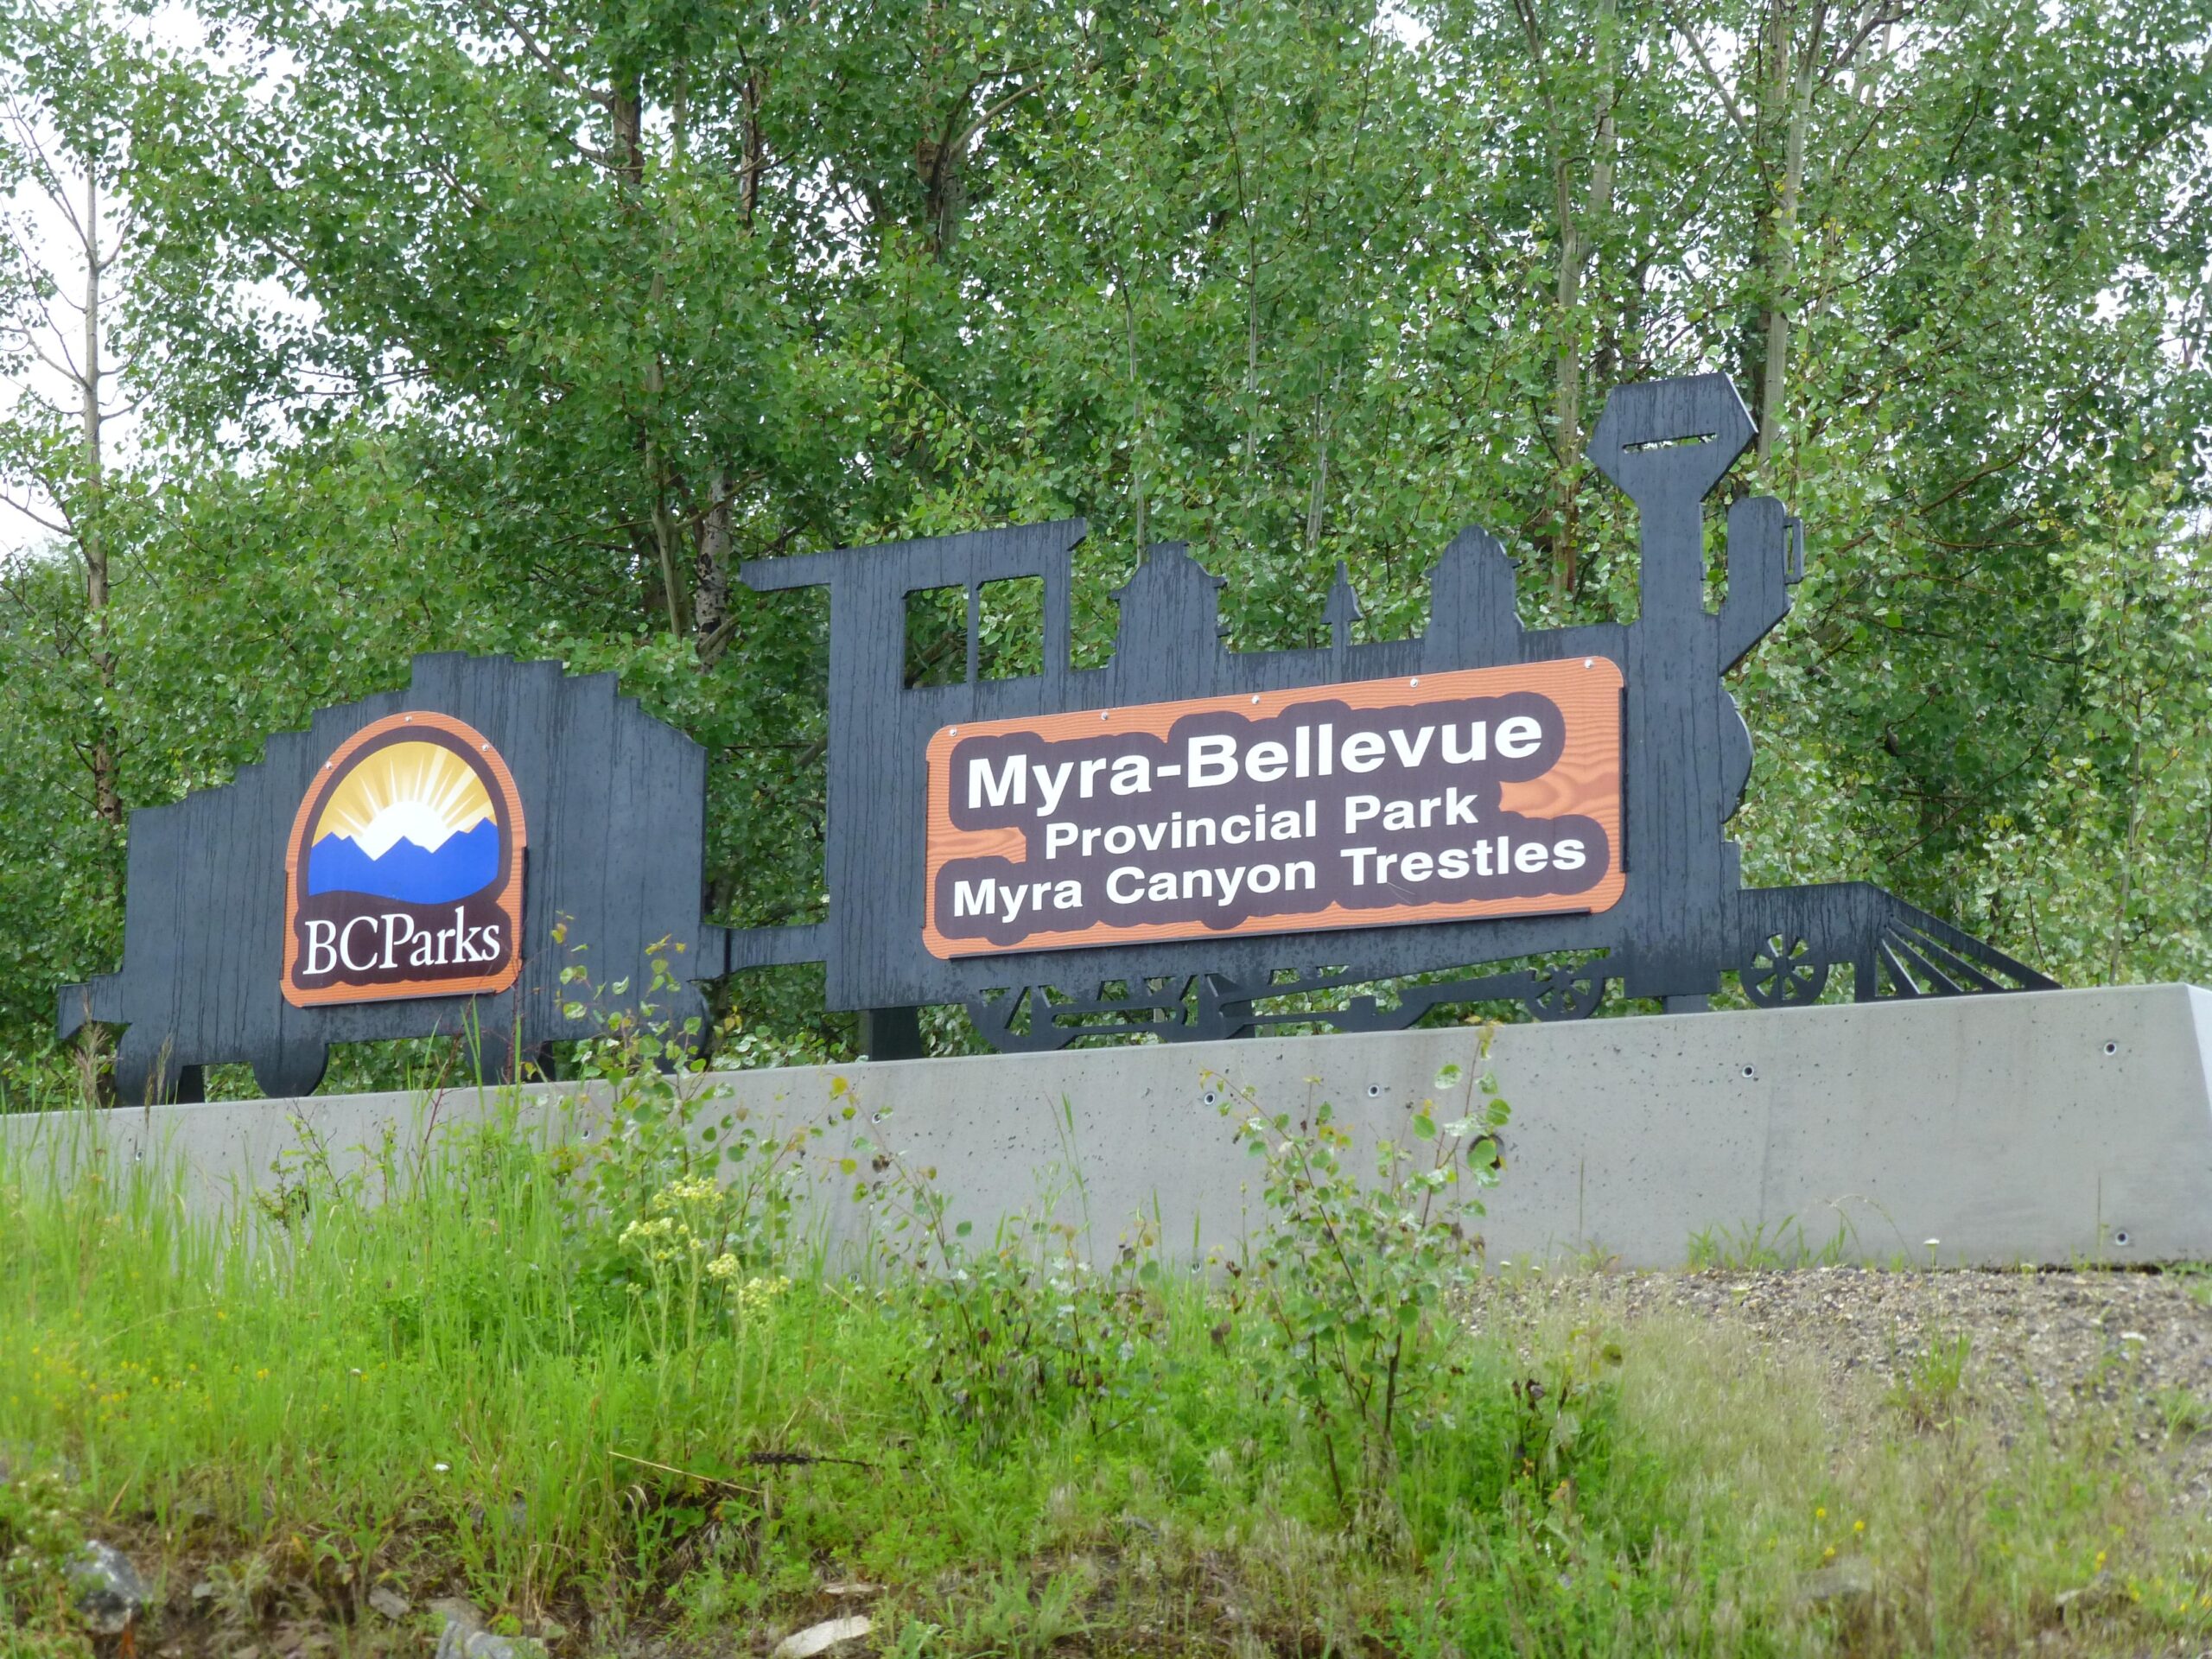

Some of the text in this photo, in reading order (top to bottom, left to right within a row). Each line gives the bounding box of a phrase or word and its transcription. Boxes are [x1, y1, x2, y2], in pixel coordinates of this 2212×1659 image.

[968, 715, 1544, 817] Myra-Bellevue
[1046, 786, 1479, 860] Provincial Park
[953, 836, 1586, 924] Myra Canyon Trestles
